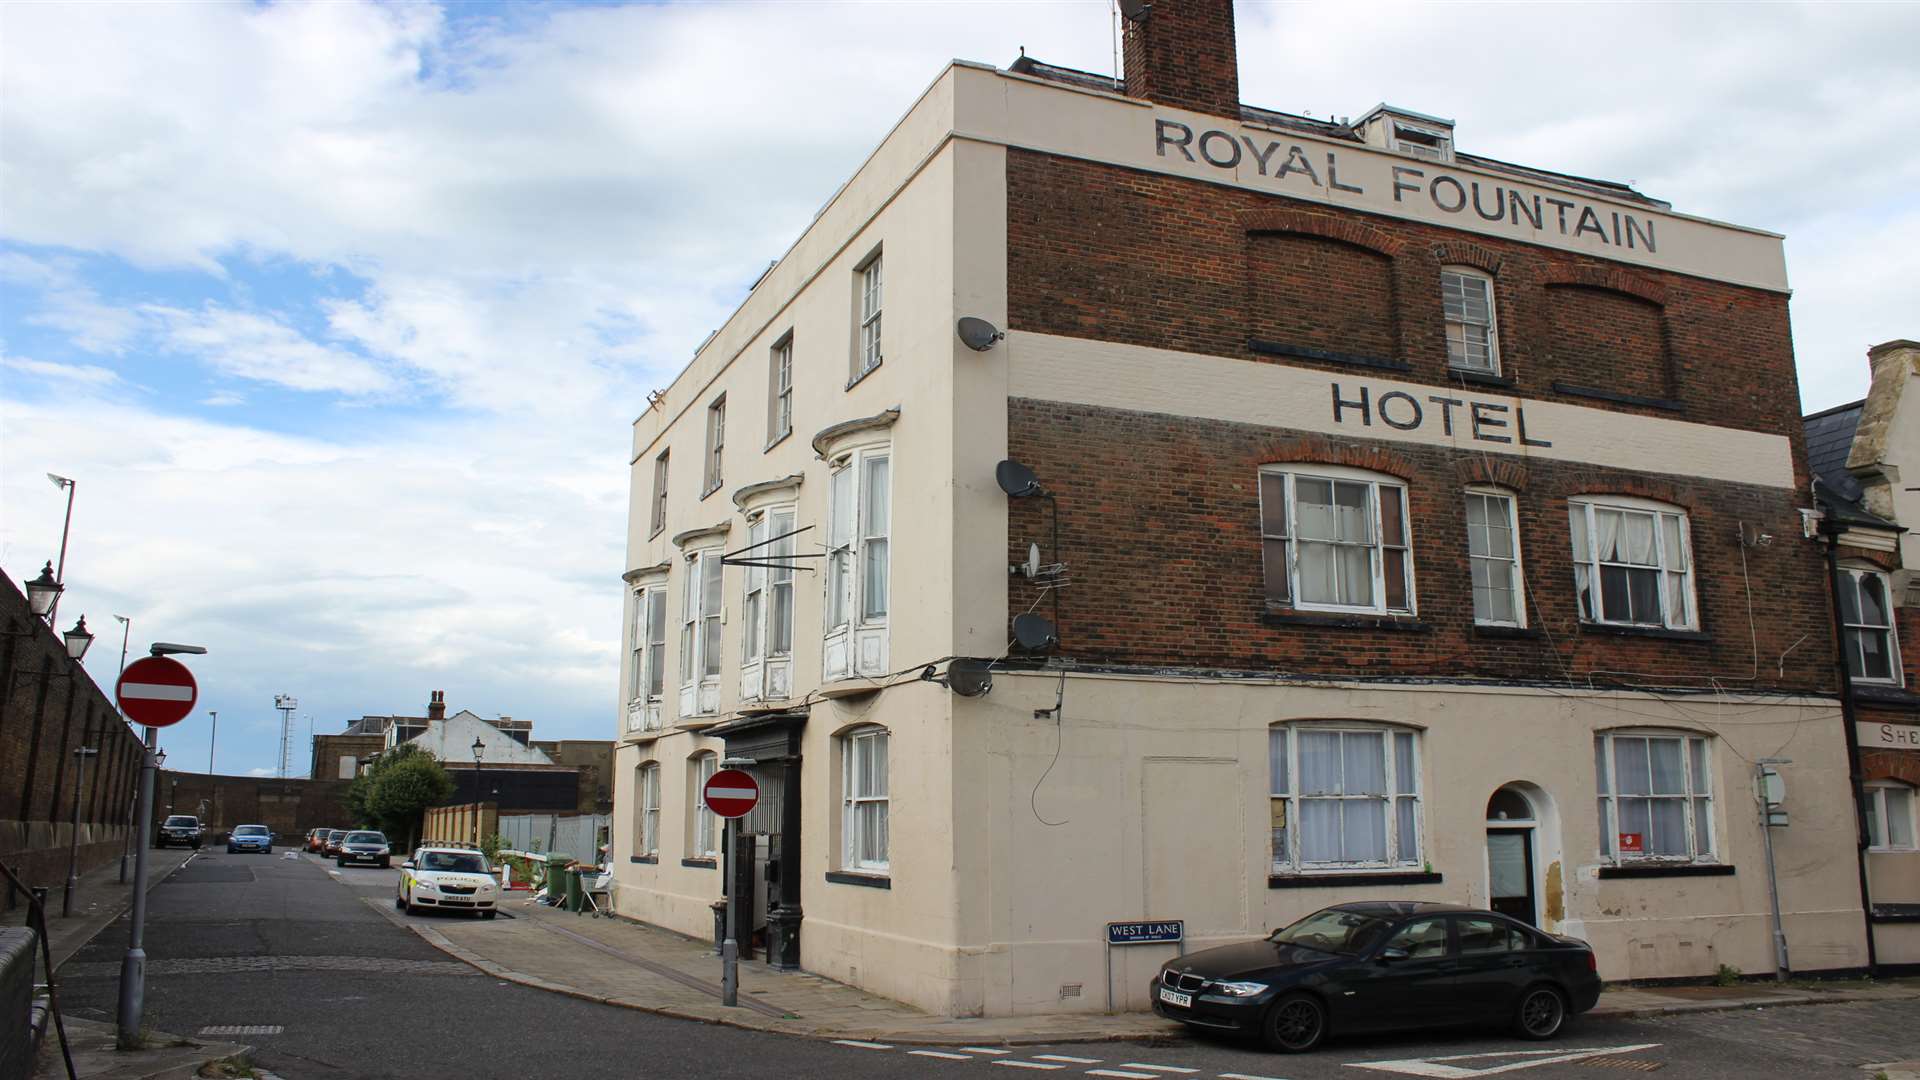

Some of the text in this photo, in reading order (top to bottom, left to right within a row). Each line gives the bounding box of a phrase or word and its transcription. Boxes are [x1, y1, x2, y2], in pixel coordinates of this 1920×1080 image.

[1155, 119, 1656, 253] ROYAL FOUNTAIN
[1332, 383, 1552, 448] HOTEL
[1112, 924, 1178, 936] WEST LANE
[1175, 993, 1189, 1005] YPR
